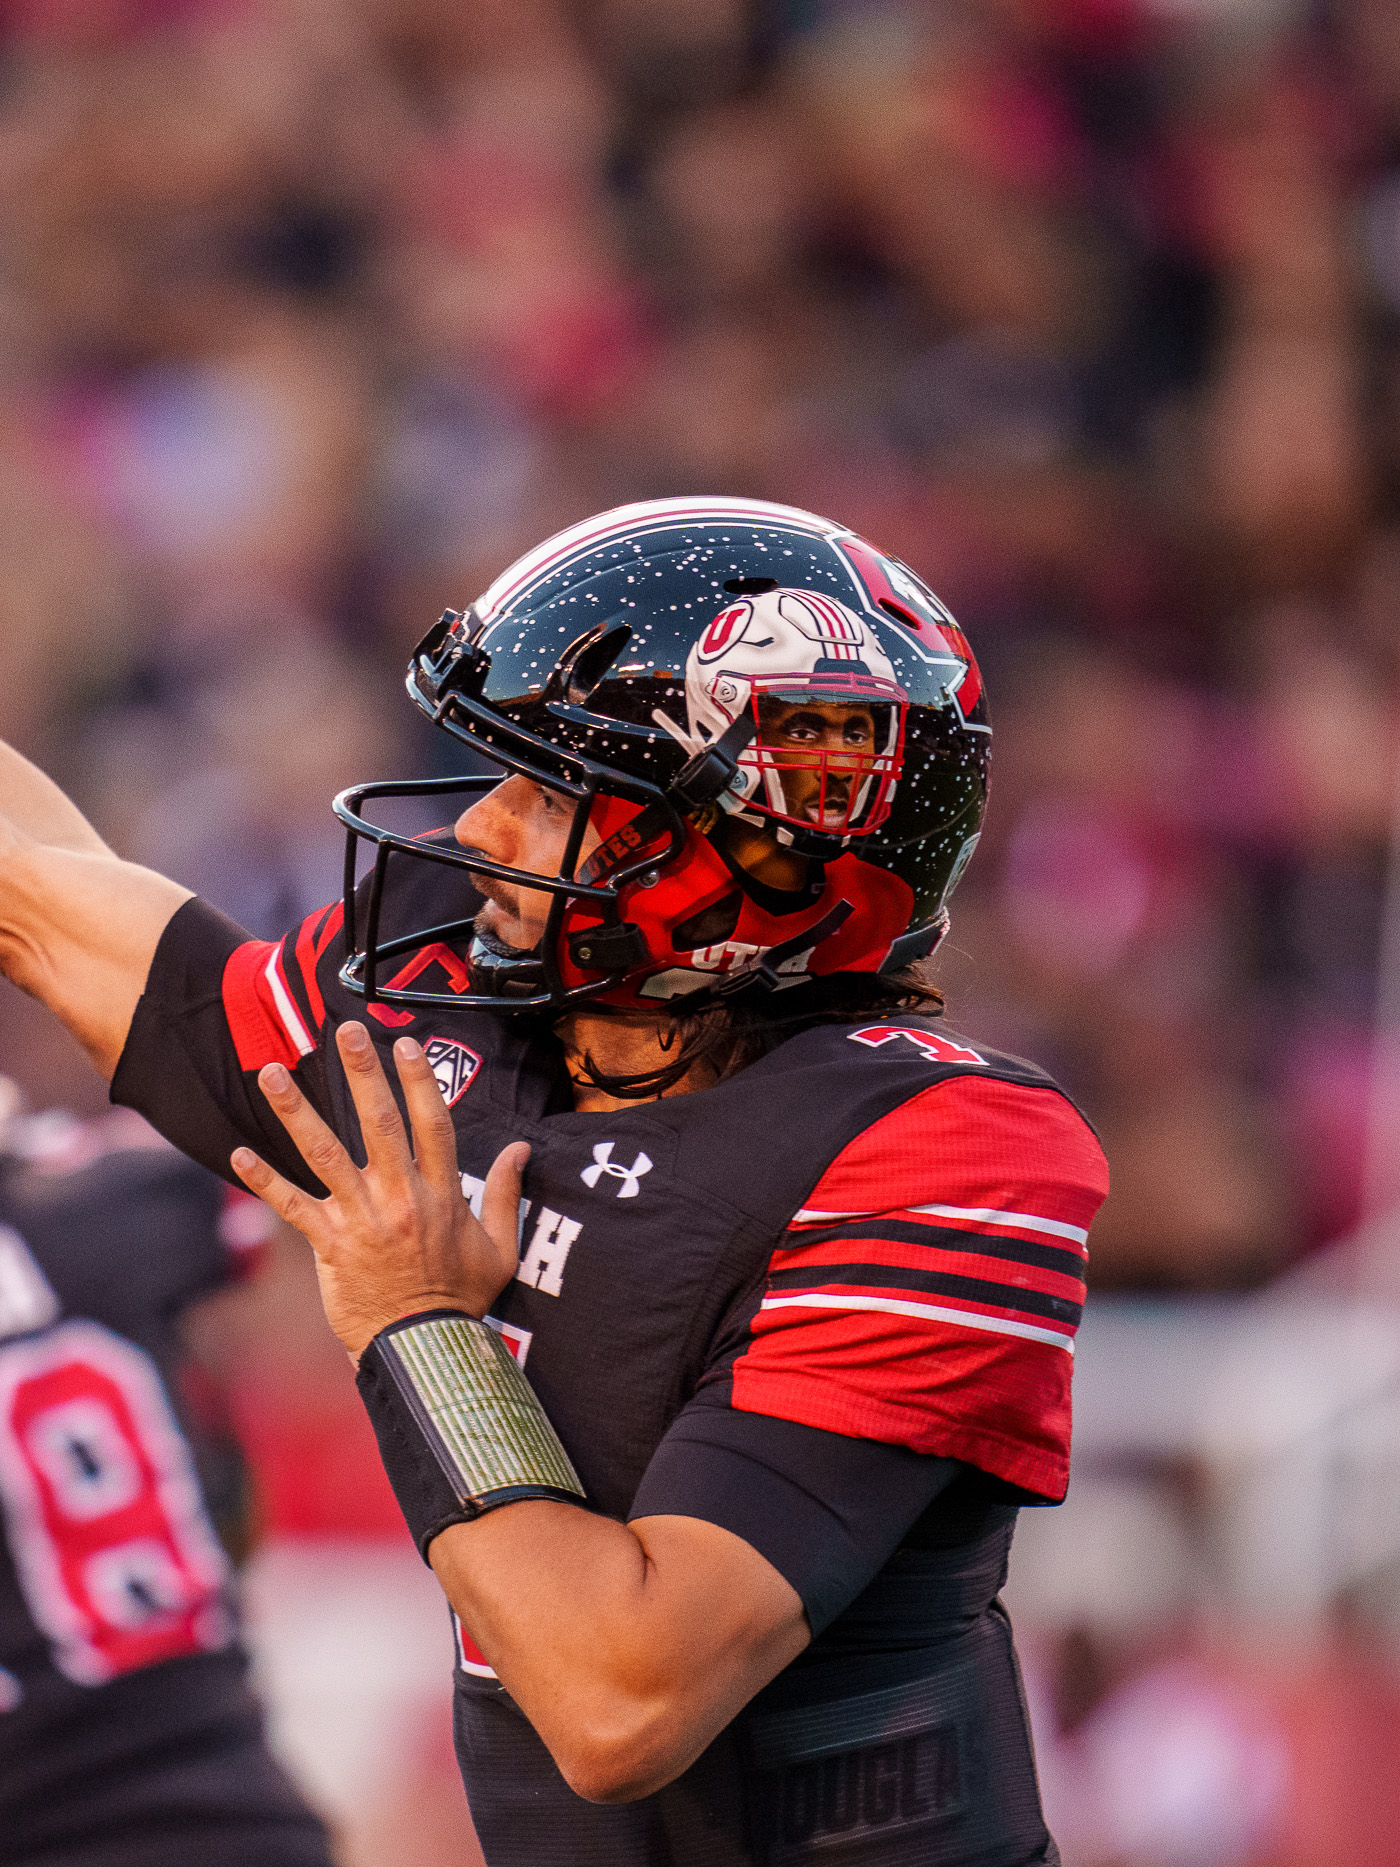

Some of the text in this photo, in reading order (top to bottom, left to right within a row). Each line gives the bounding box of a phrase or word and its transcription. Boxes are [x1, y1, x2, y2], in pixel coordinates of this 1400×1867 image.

[703, 609, 747, 654] U
[585, 825, 641, 877] UTES
[847, 1026, 990, 1066] 7
